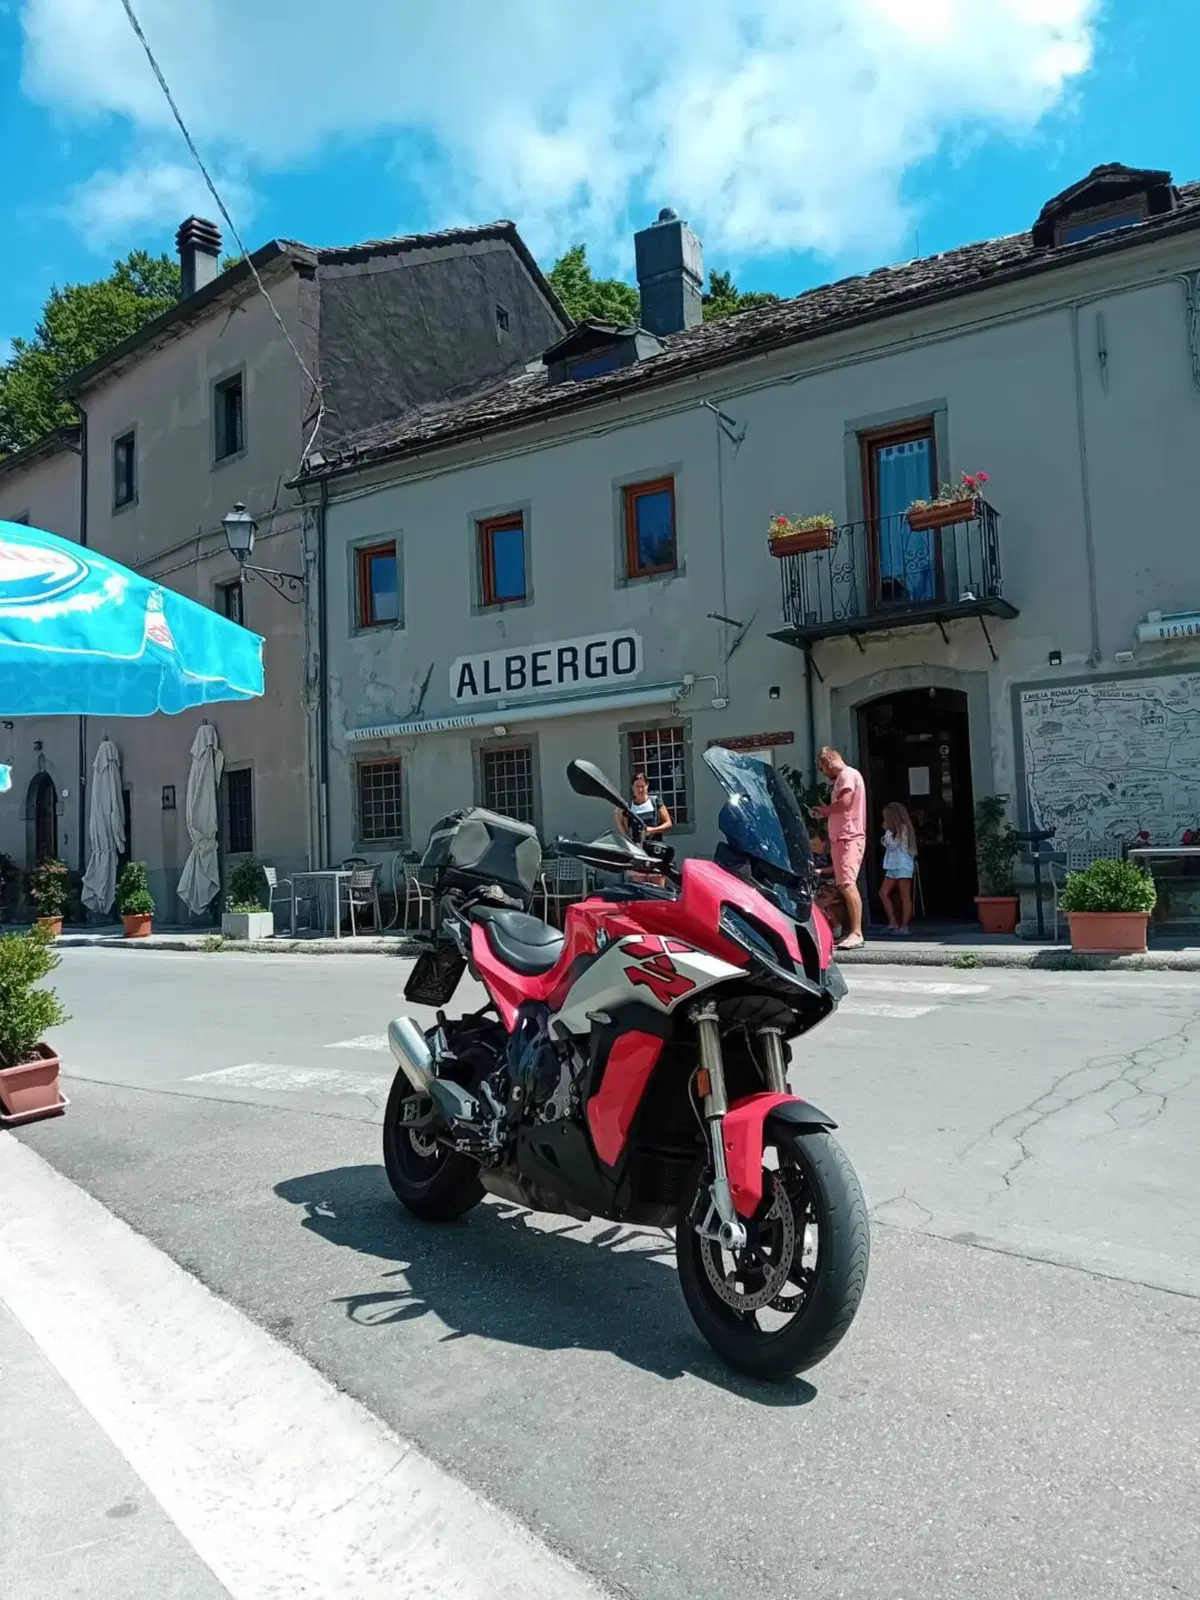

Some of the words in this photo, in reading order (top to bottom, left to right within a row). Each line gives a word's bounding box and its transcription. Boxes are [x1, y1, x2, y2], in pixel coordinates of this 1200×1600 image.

[456, 636, 637, 699] ALBERGO
[1023, 692, 1049, 701] EMILIA
[1050, 688, 1089, 698] ROMAGNA
